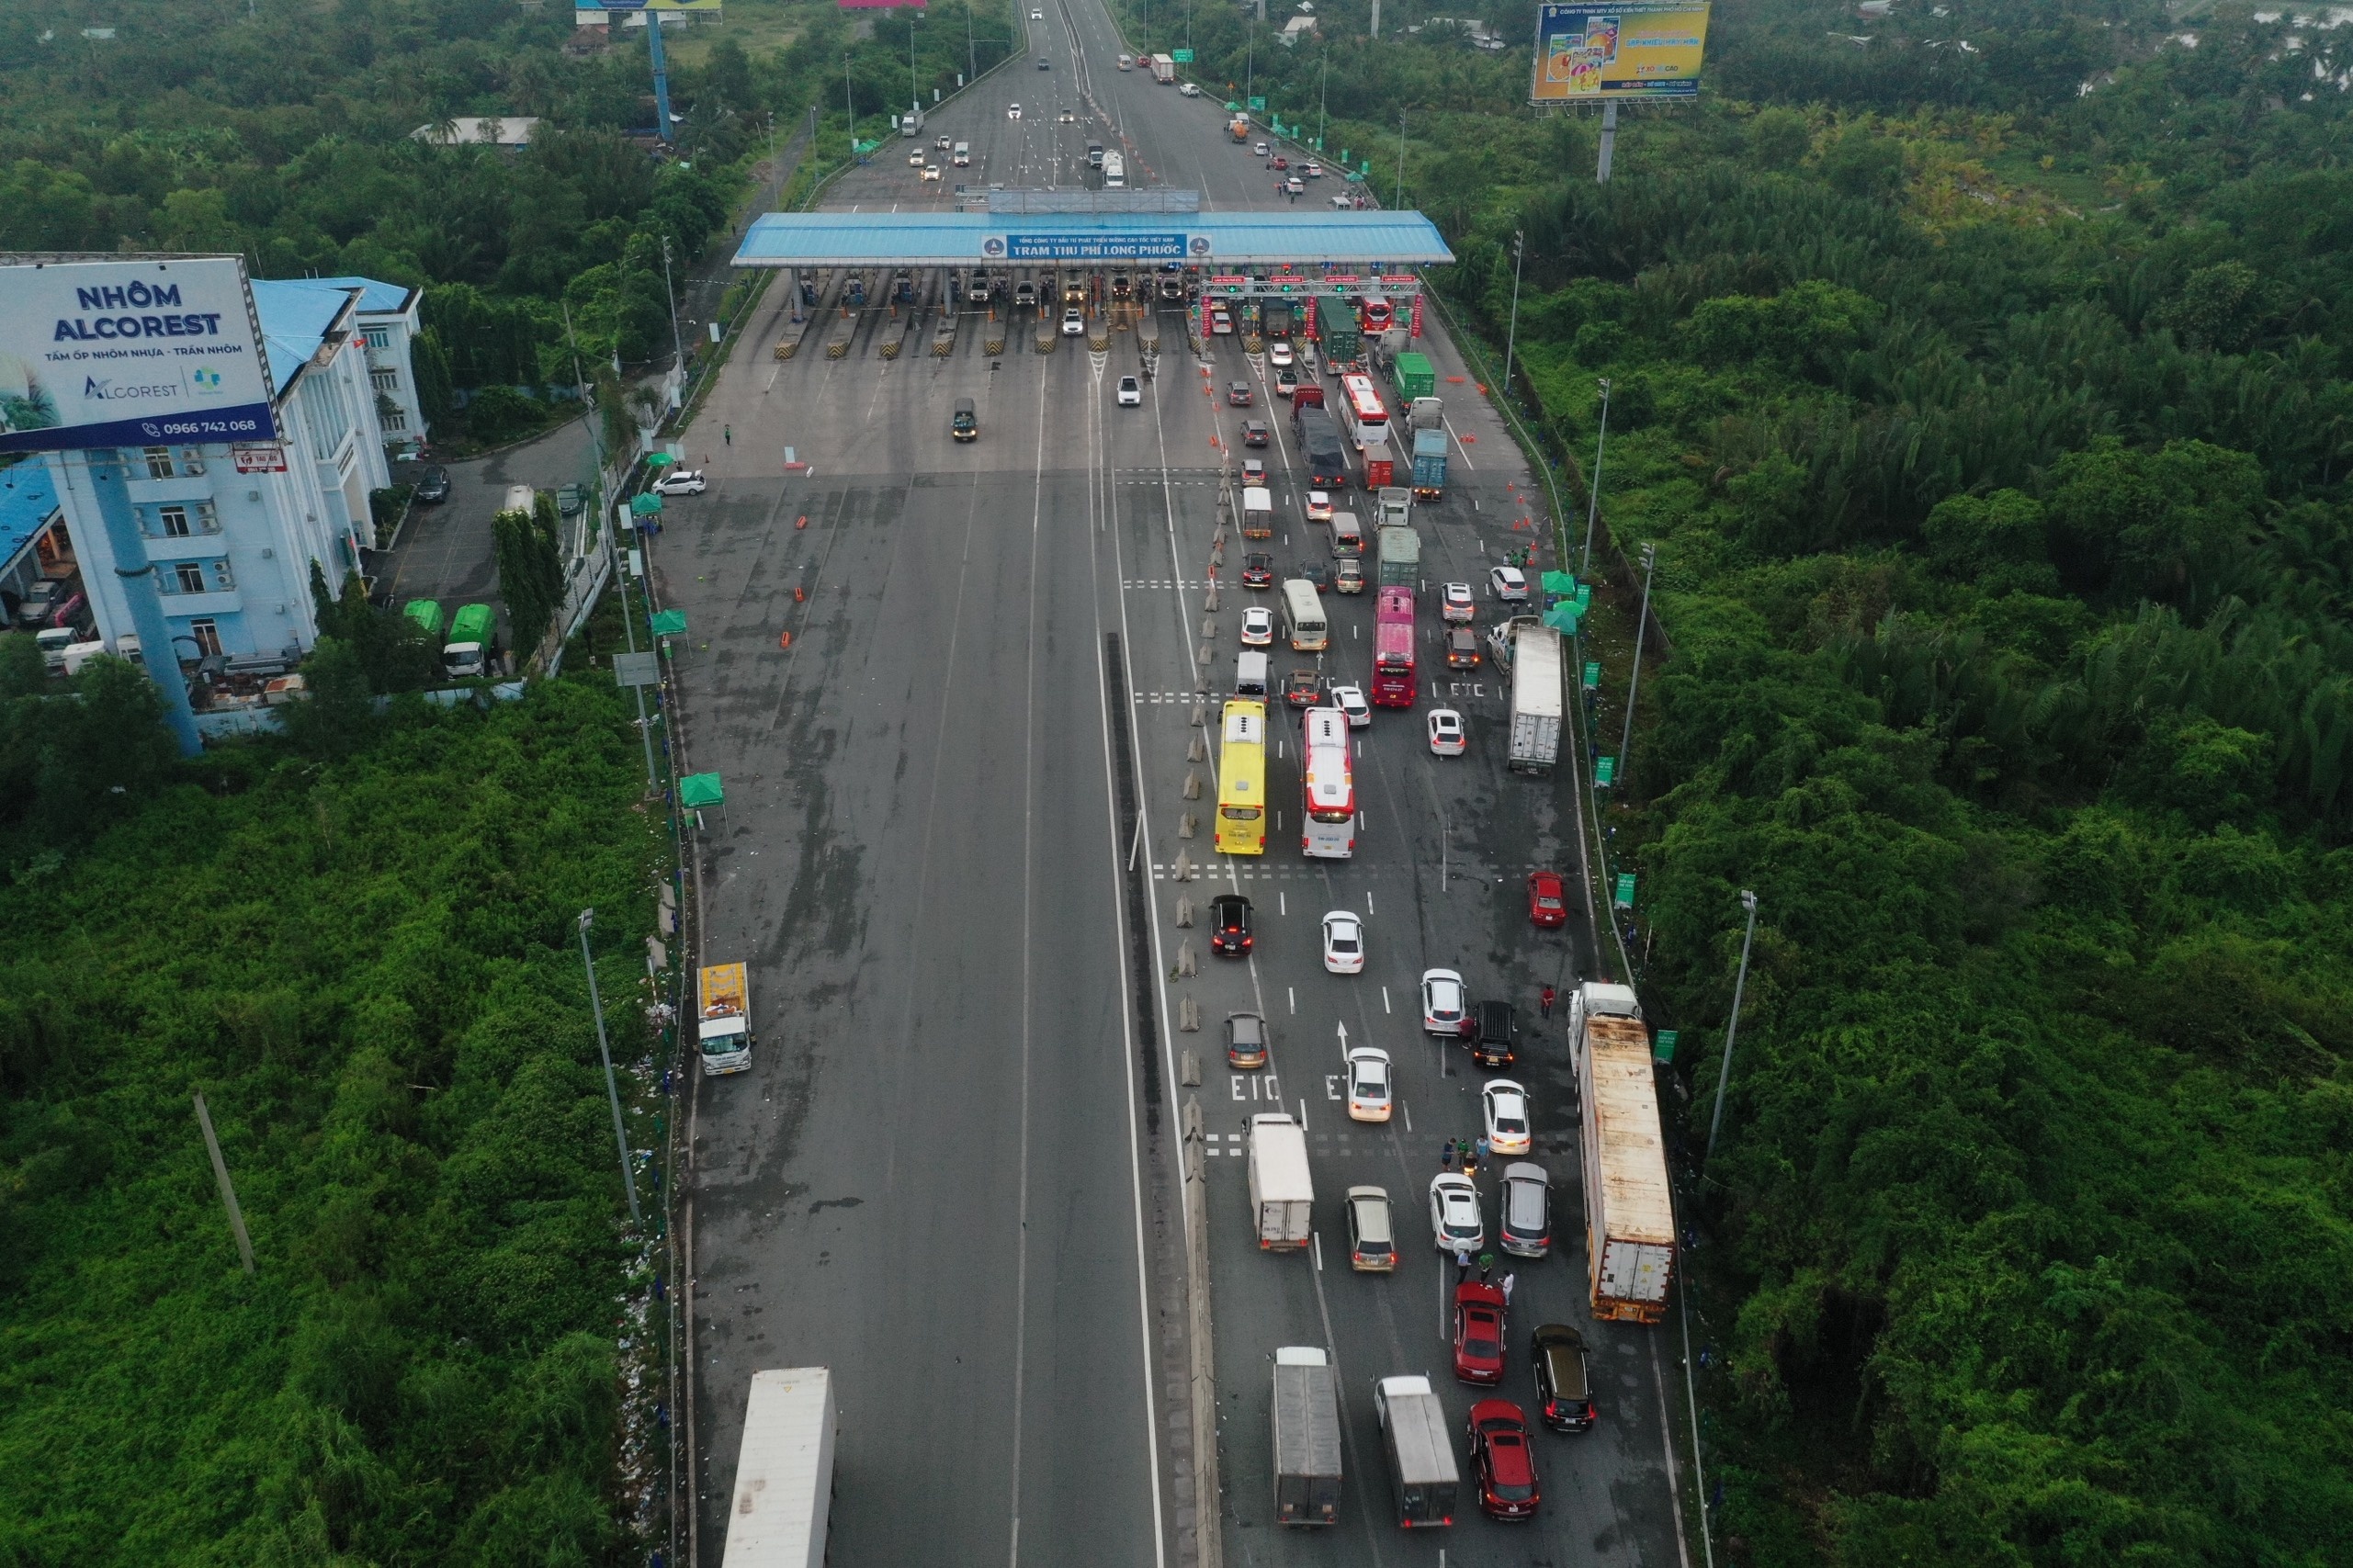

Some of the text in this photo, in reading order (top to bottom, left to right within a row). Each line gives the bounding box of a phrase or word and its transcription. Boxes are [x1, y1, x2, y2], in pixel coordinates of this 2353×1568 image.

[1014, 243, 1181, 257] TRẠM THU PHÍ LONG PHƯỚC
[77, 280, 181, 310] NHÔM
[53, 313, 221, 342] ALCOREST
[45, 344, 242, 361] TẤM ỐP NHÔM NHỰA TRẦN NHÔM
[85, 375, 177, 400] ALCOREST
[164, 420, 256, 434] 0966 742 068
[1450, 683, 1484, 697] ETC
